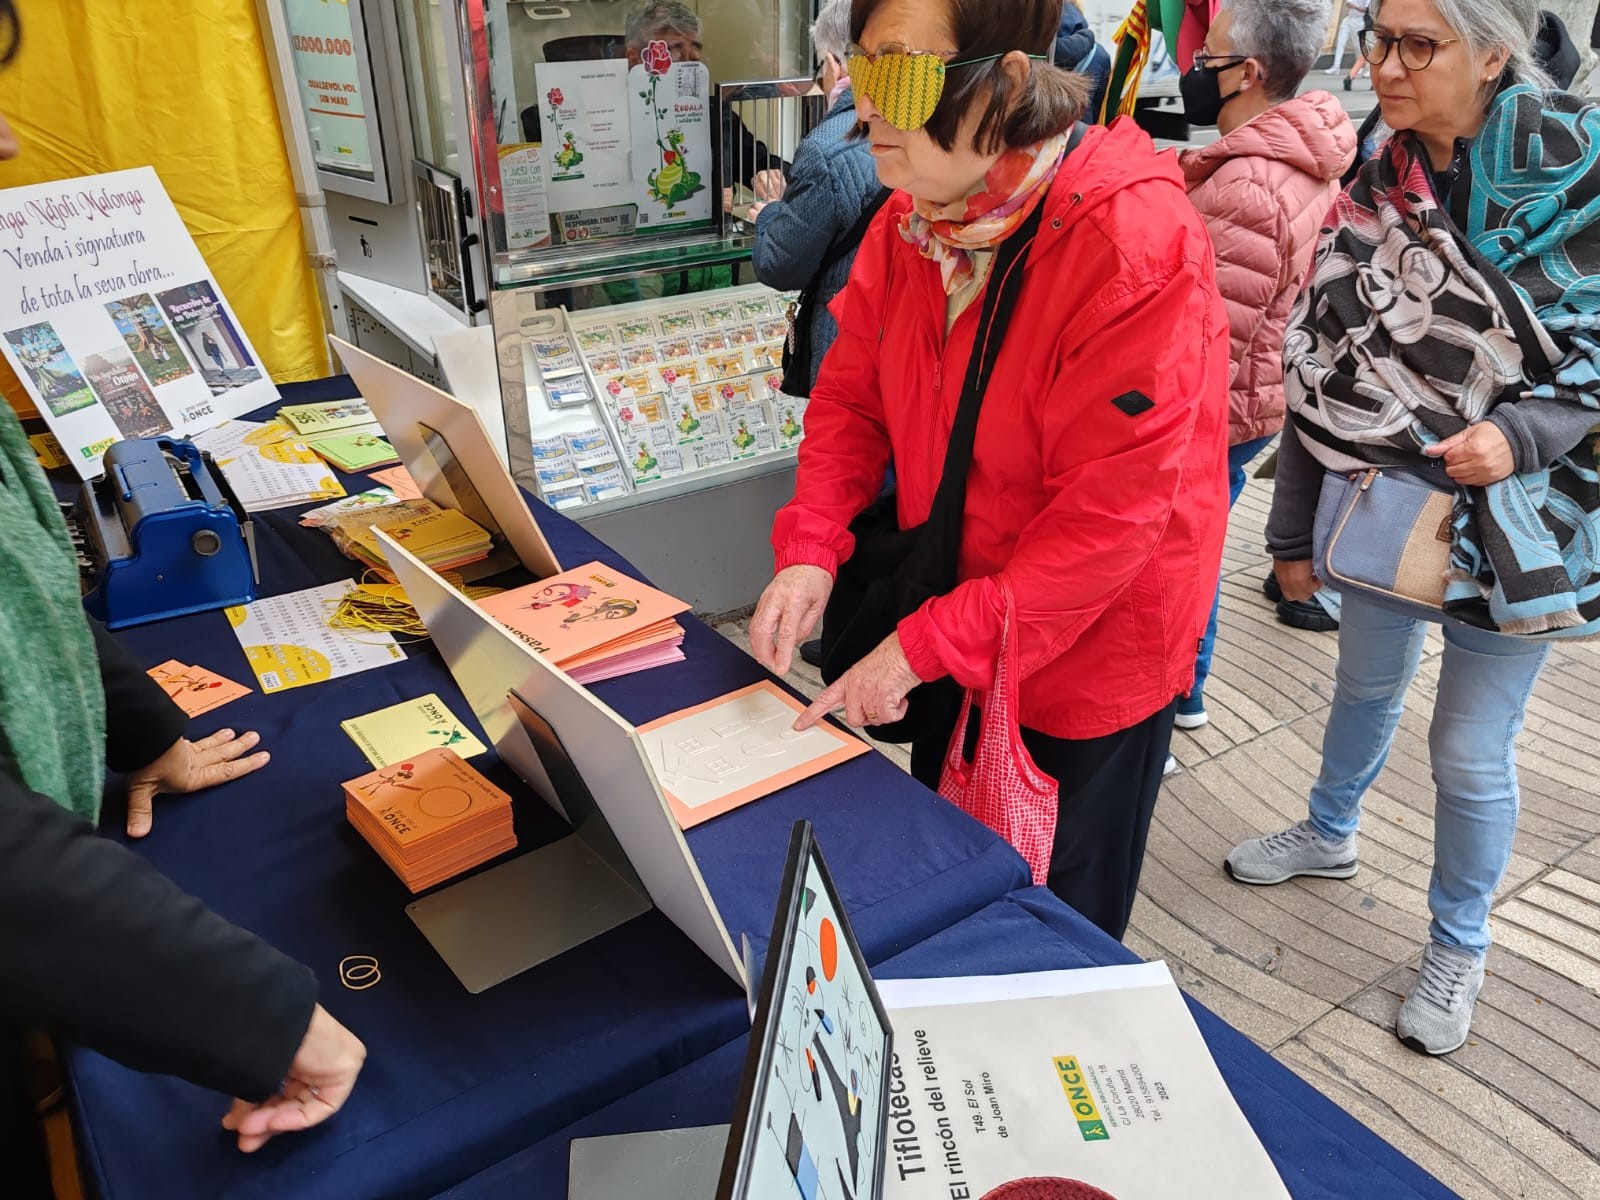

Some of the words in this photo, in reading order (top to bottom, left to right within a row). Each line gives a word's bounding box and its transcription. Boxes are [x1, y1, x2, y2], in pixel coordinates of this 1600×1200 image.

[76, 188, 146, 221] Malonga
[3, 236, 65, 270] Venda
[65, 240, 73, 258] i
[75, 228, 146, 267] signatura
[20, 286, 40, 315] de
[40, 283, 75, 310] tota
[73, 273, 93, 301] la
[94, 276, 126, 296] seva
[128, 260, 175, 287] obra...
[112, 372, 139, 385] Otoño
[189, 405, 214, 420] ONCE
[424, 703, 443, 719] ONCE
[384, 814, 411, 834] ONCE
[914, 1029, 938, 1081] relieve
[961, 1079, 975, 1096] Sol
[979, 1072, 995, 1095] Miró
[1058, 1060, 1093, 1115] ONCE
[1154, 1081, 1170, 1100] 2023
[924, 1086, 946, 1112] del
[967, 1098, 979, 1109] El
[989, 1097, 1003, 1122] Joan
[1118, 1106, 1127, 1116] La
[972, 1111, 987, 1134] T49.
[997, 1125, 1009, 1138] de
[935, 1117, 964, 1175] rincón
[949, 1181, 970, 1200] El
